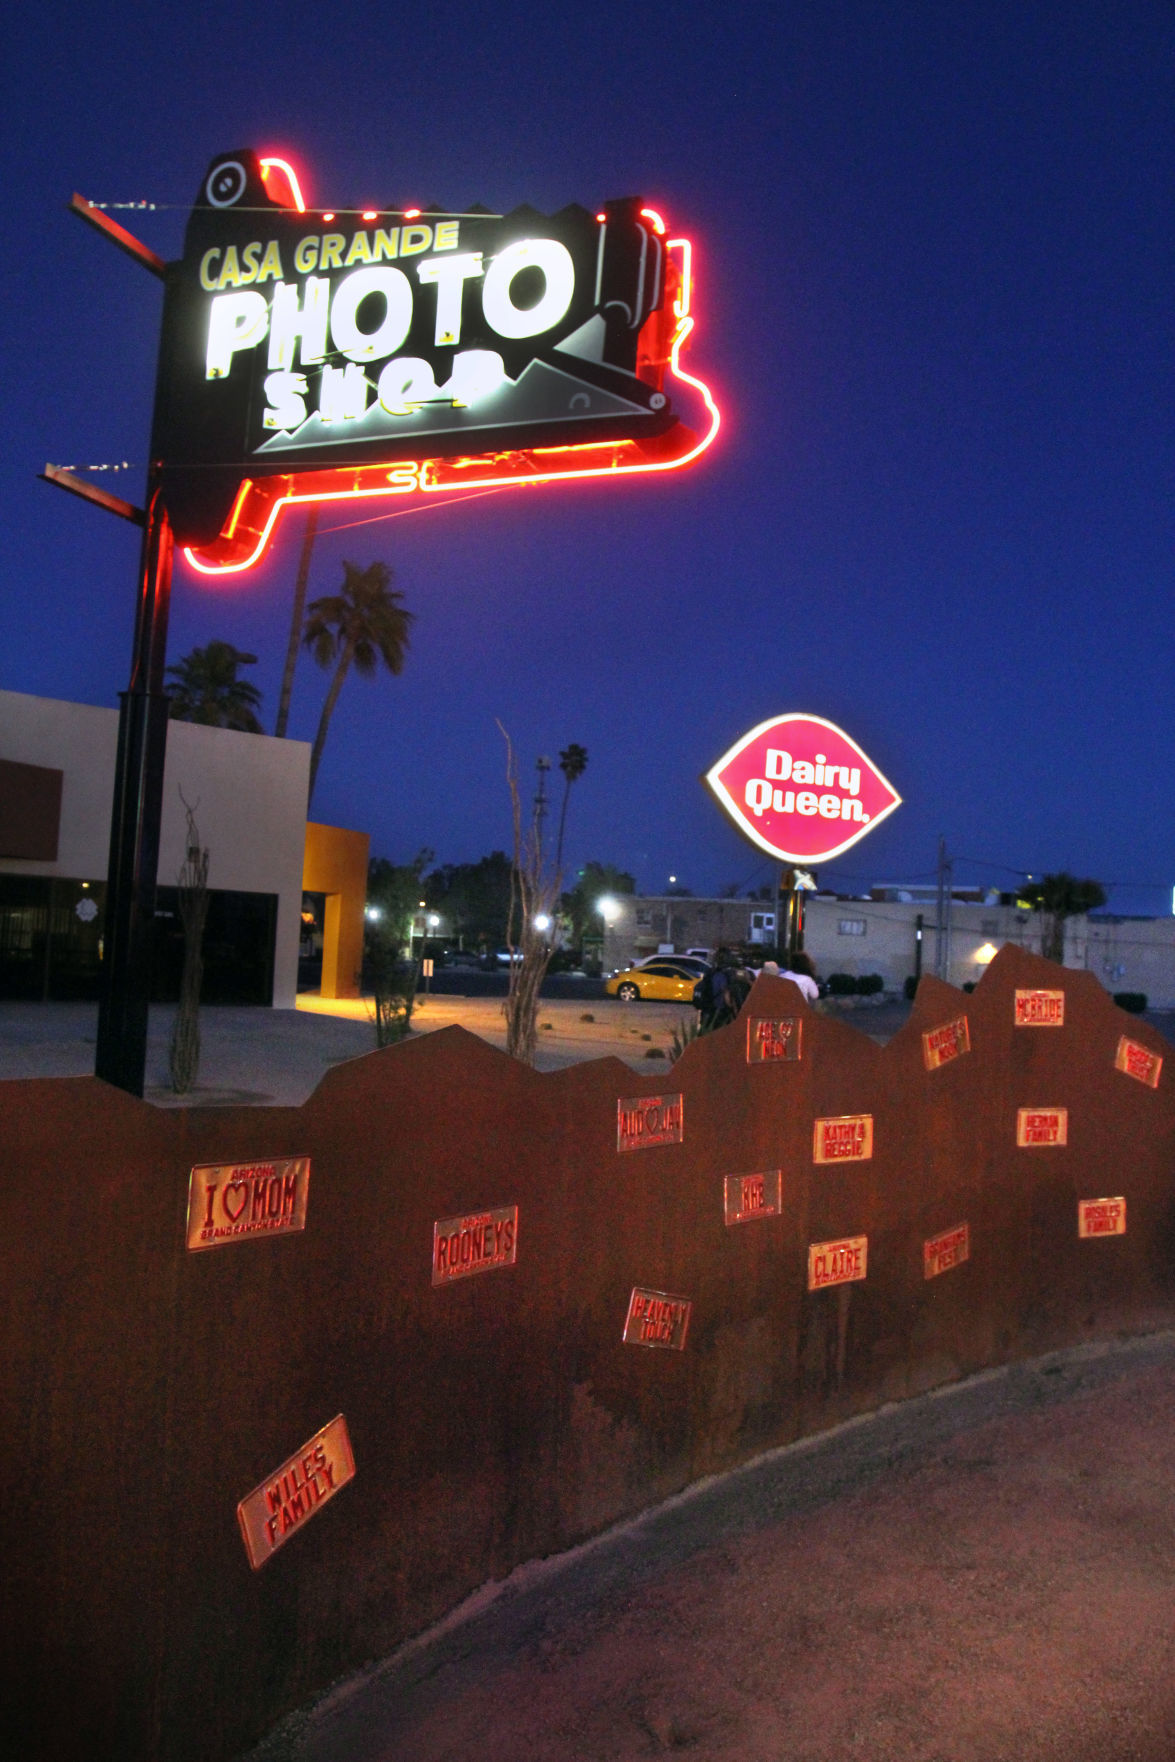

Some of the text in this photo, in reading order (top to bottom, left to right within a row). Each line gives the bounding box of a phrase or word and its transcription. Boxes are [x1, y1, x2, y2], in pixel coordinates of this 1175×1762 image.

[200, 220, 460, 291] CASA GRANDE
[205, 238, 576, 381] PHOTO
[262, 349, 508, 431] SHOP
[765, 748, 861, 796] Dairy
[824, 1122, 857, 1141] KATHY
[825, 1141, 865, 1159] REGGIE
[230, 1165, 277, 1181] ARIZONA
[204, 1174, 299, 1229] I MOM
[437, 1220, 514, 1272] ROONEYS
[814, 1248, 861, 1279] CLAIRE
[264, 1461, 334, 1546] FAMILY
[266, 1445, 326, 1515] WILES
